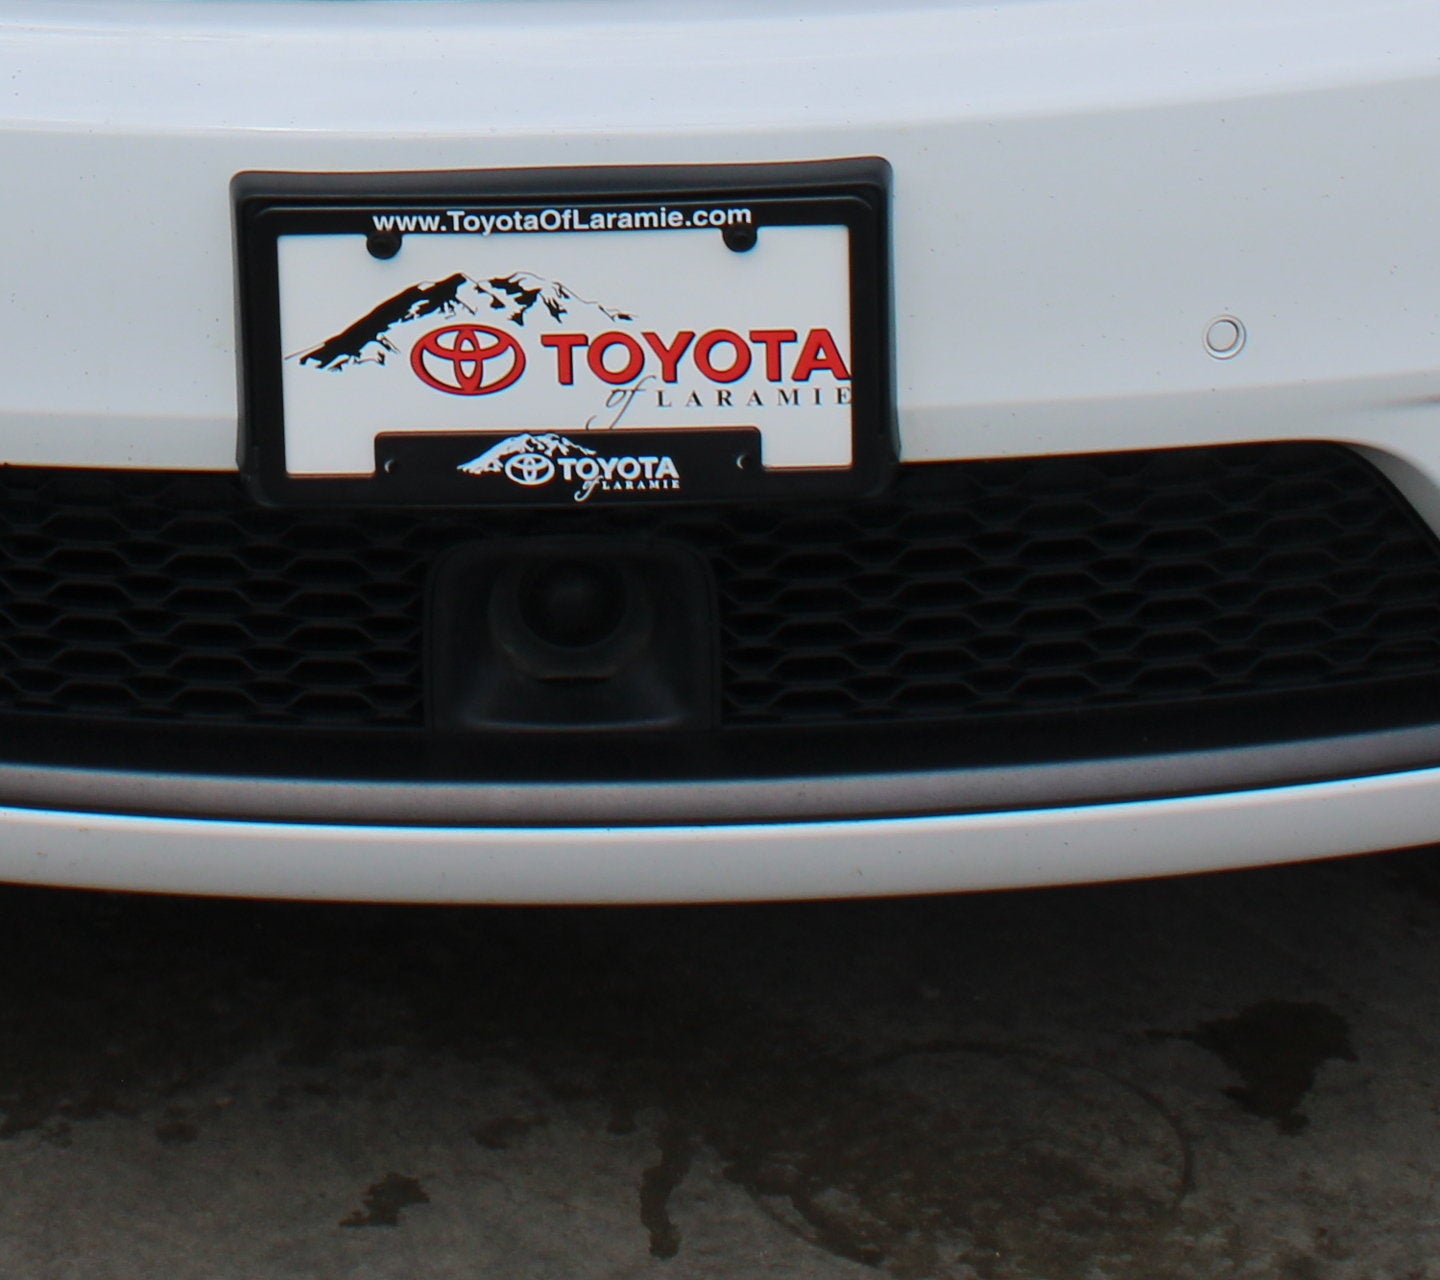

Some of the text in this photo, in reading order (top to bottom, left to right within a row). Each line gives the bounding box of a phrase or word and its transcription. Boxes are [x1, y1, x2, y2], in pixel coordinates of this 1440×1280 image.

[372, 206, 752, 237] www.ToyotaOfLaramie.com
[540, 327, 852, 386] TOYOTA
[585, 375, 852, 430] of LARAMIE
[556, 455, 681, 481] TOYOTA
[601, 478, 681, 491] LARAMIE
